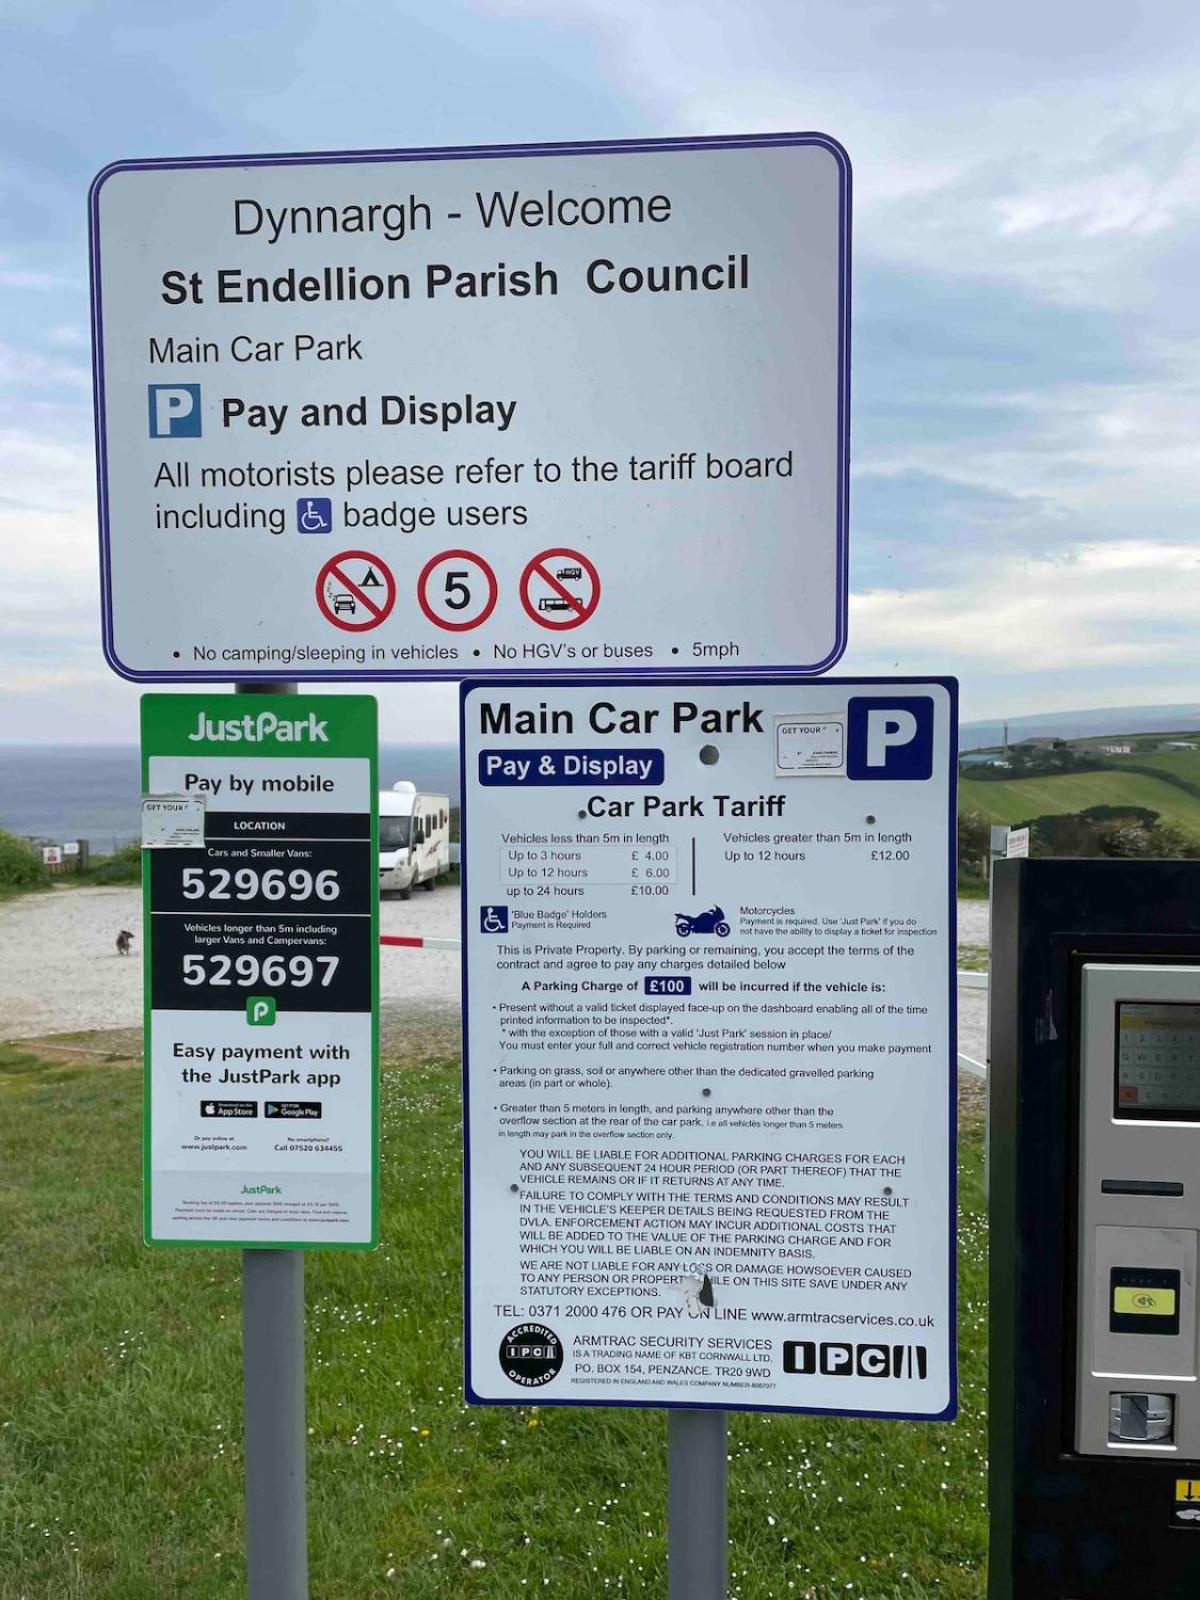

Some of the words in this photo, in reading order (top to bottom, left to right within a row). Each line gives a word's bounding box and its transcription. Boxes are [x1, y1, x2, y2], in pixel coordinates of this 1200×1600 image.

[234, 194, 430, 244] Dynnargh
[475, 189, 671, 228] Welcome
[162, 270, 202, 304] St
[218, 266, 409, 303] Endellion
[427, 261, 557, 298] Parish
[587, 254, 747, 294] Council
[150, 336, 218, 363] Main
[231, 335, 282, 362] Car
[295, 333, 361, 360] Park
[156, 390, 194, 434] P
[223, 398, 287, 435] Pay
[301, 396, 366, 426] and
[381, 394, 516, 431] Display
[154, 461, 188, 488] All
[201, 460, 334, 487] motorists
[347, 459, 443, 492] please
[456, 457, 523, 484] refer
[534, 458, 560, 482] to
[572, 455, 618, 481] the
[629, 452, 696, 480] tariff
[706, 450, 792, 478] board
[156, 502, 284, 534] including
[344, 500, 434, 533] badge
[447, 505, 527, 526] users
[444, 572, 471, 610] 5
[193, 646, 216, 660] No
[222, 645, 365, 664] camping/sleeping
[371, 645, 384, 659] in
[391, 644, 458, 659] vehicles
[494, 644, 516, 658] No
[523, 643, 575, 658] HGV's
[581, 646, 597, 657] or
[604, 643, 652, 657] buses
[692, 641, 738, 660] 5mph
[188, 711, 328, 741] JustPark
[480, 702, 572, 734] Main
[589, 702, 658, 734] Car
[673, 701, 762, 733] Park
[866, 708, 918, 768] P
[487, 755, 530, 780] Pay
[538, 755, 555, 775] &
[564, 755, 652, 779] Display
[185, 773, 221, 794] Pay
[230, 774, 254, 795] by
[262, 774, 334, 792] mobile
[587, 795, 634, 817] Car
[644, 795, 704, 816] Park
[712, 794, 786, 816] Tariff
[234, 821, 285, 830] LOCATION
[501, 833, 547, 843] Vehicles
[550, 833, 572, 843] less
[576, 833, 599, 843] than
[603, 833, 620, 843] 5m
[623, 832, 632, 843] in
[636, 832, 669, 844] length
[723, 832, 770, 842] Vehicles
[773, 832, 812, 844] greater
[816, 832, 840, 842] than
[844, 832, 861, 842] 5m
[864, 832, 874, 842] in
[878, 832, 912, 844] length
[207, 847, 228, 856] Cars
[230, 848, 248, 857] and
[250, 848, 285, 857] Smaller
[286, 849, 311, 857] Vans:
[508, 850, 524, 862] Up
[527, 850, 537, 860] to
[540, 850, 547, 860] 3
[550, 851, 581, 860] hours
[631, 850, 638, 860] £
[644, 850, 668, 861] 4.00
[724, 850, 740, 862] Up
[743, 851, 754, 860] to
[758, 850, 771, 860] 12
[774, 850, 805, 860] hours
[871, 850, 909, 860] £12.00
[508, 867, 523, 878] Up
[527, 868, 537, 877] to
[541, 867, 554, 877] 12
[557, 867, 587, 877] hours
[631, 867, 638, 877] £
[645, 867, 669, 878] 6.00
[182, 868, 339, 900] 529696
[506, 888, 520, 898] up
[523, 887, 533, 895] to
[537, 885, 550, 895] 24
[554, 886, 584, 895] hours
[631, 885, 668, 895] £10.00
[511, 910, 534, 919] 'Blue
[537, 910, 568, 920] Badge'
[572, 910, 606, 918] Holders
[740, 906, 795, 918] Motorcycles
[184, 923, 221, 932] Vehicles
[224, 923, 253, 934] longer
[256, 924, 275, 932] than
[278, 924, 293, 932] 5m
[296, 924, 337, 935] including
[194, 935, 221, 945] larger
[222, 935, 245, 944] Vans
[247, 936, 264, 944] and
[266, 935, 326, 946] Campervans:
[183, 954, 338, 987] 529697
[522, 981, 530, 990] A
[534, 981, 577, 992] Parking
[581, 981, 622, 992] Charge
[626, 981, 638, 990] of
[649, 979, 684, 992] £100
[698, 981, 718, 990] will
[722, 981, 736, 990] be
[740, 981, 789, 991] incurred
[792, 981, 800, 991] if
[803, 982, 822, 991] the
[825, 982, 867, 992] vehicle
[871, 982, 885, 992] is:
[173, 1042, 215, 1061] Easy
[222, 1045, 303, 1062] payment
[309, 1044, 349, 1059] with
[181, 1068, 211, 1082] the
[218, 1068, 299, 1084] JustPark
[306, 1073, 340, 1087] app
[218, 1107, 233, 1116] App
[280, 1108, 304, 1117] Google
[241, 1184, 281, 1194] JustPark
[520, 1286, 584, 1295] STATUTORY
[587, 1286, 661, 1296] EXCEPTIONS.
[494, 1304, 524, 1317] TEL:
[528, 1305, 558, 1317] 0371
[565, 1305, 597, 1317] 2000
[602, 1305, 626, 1318] 476
[631, 1306, 652, 1318] OR
[657, 1306, 683, 1318] PAY
[714, 1308, 746, 1320] LINE
[751, 1312, 934, 1327] www.armtracservices.co.uk
[507, 1325, 558, 1346] ACCREDITED
[572, 1335, 636, 1346] ARMTRAC
[639, 1336, 704, 1348] SECURITY
[707, 1337, 772, 1350] SERVICES
[508, 1368, 557, 1386] OPERATOR
